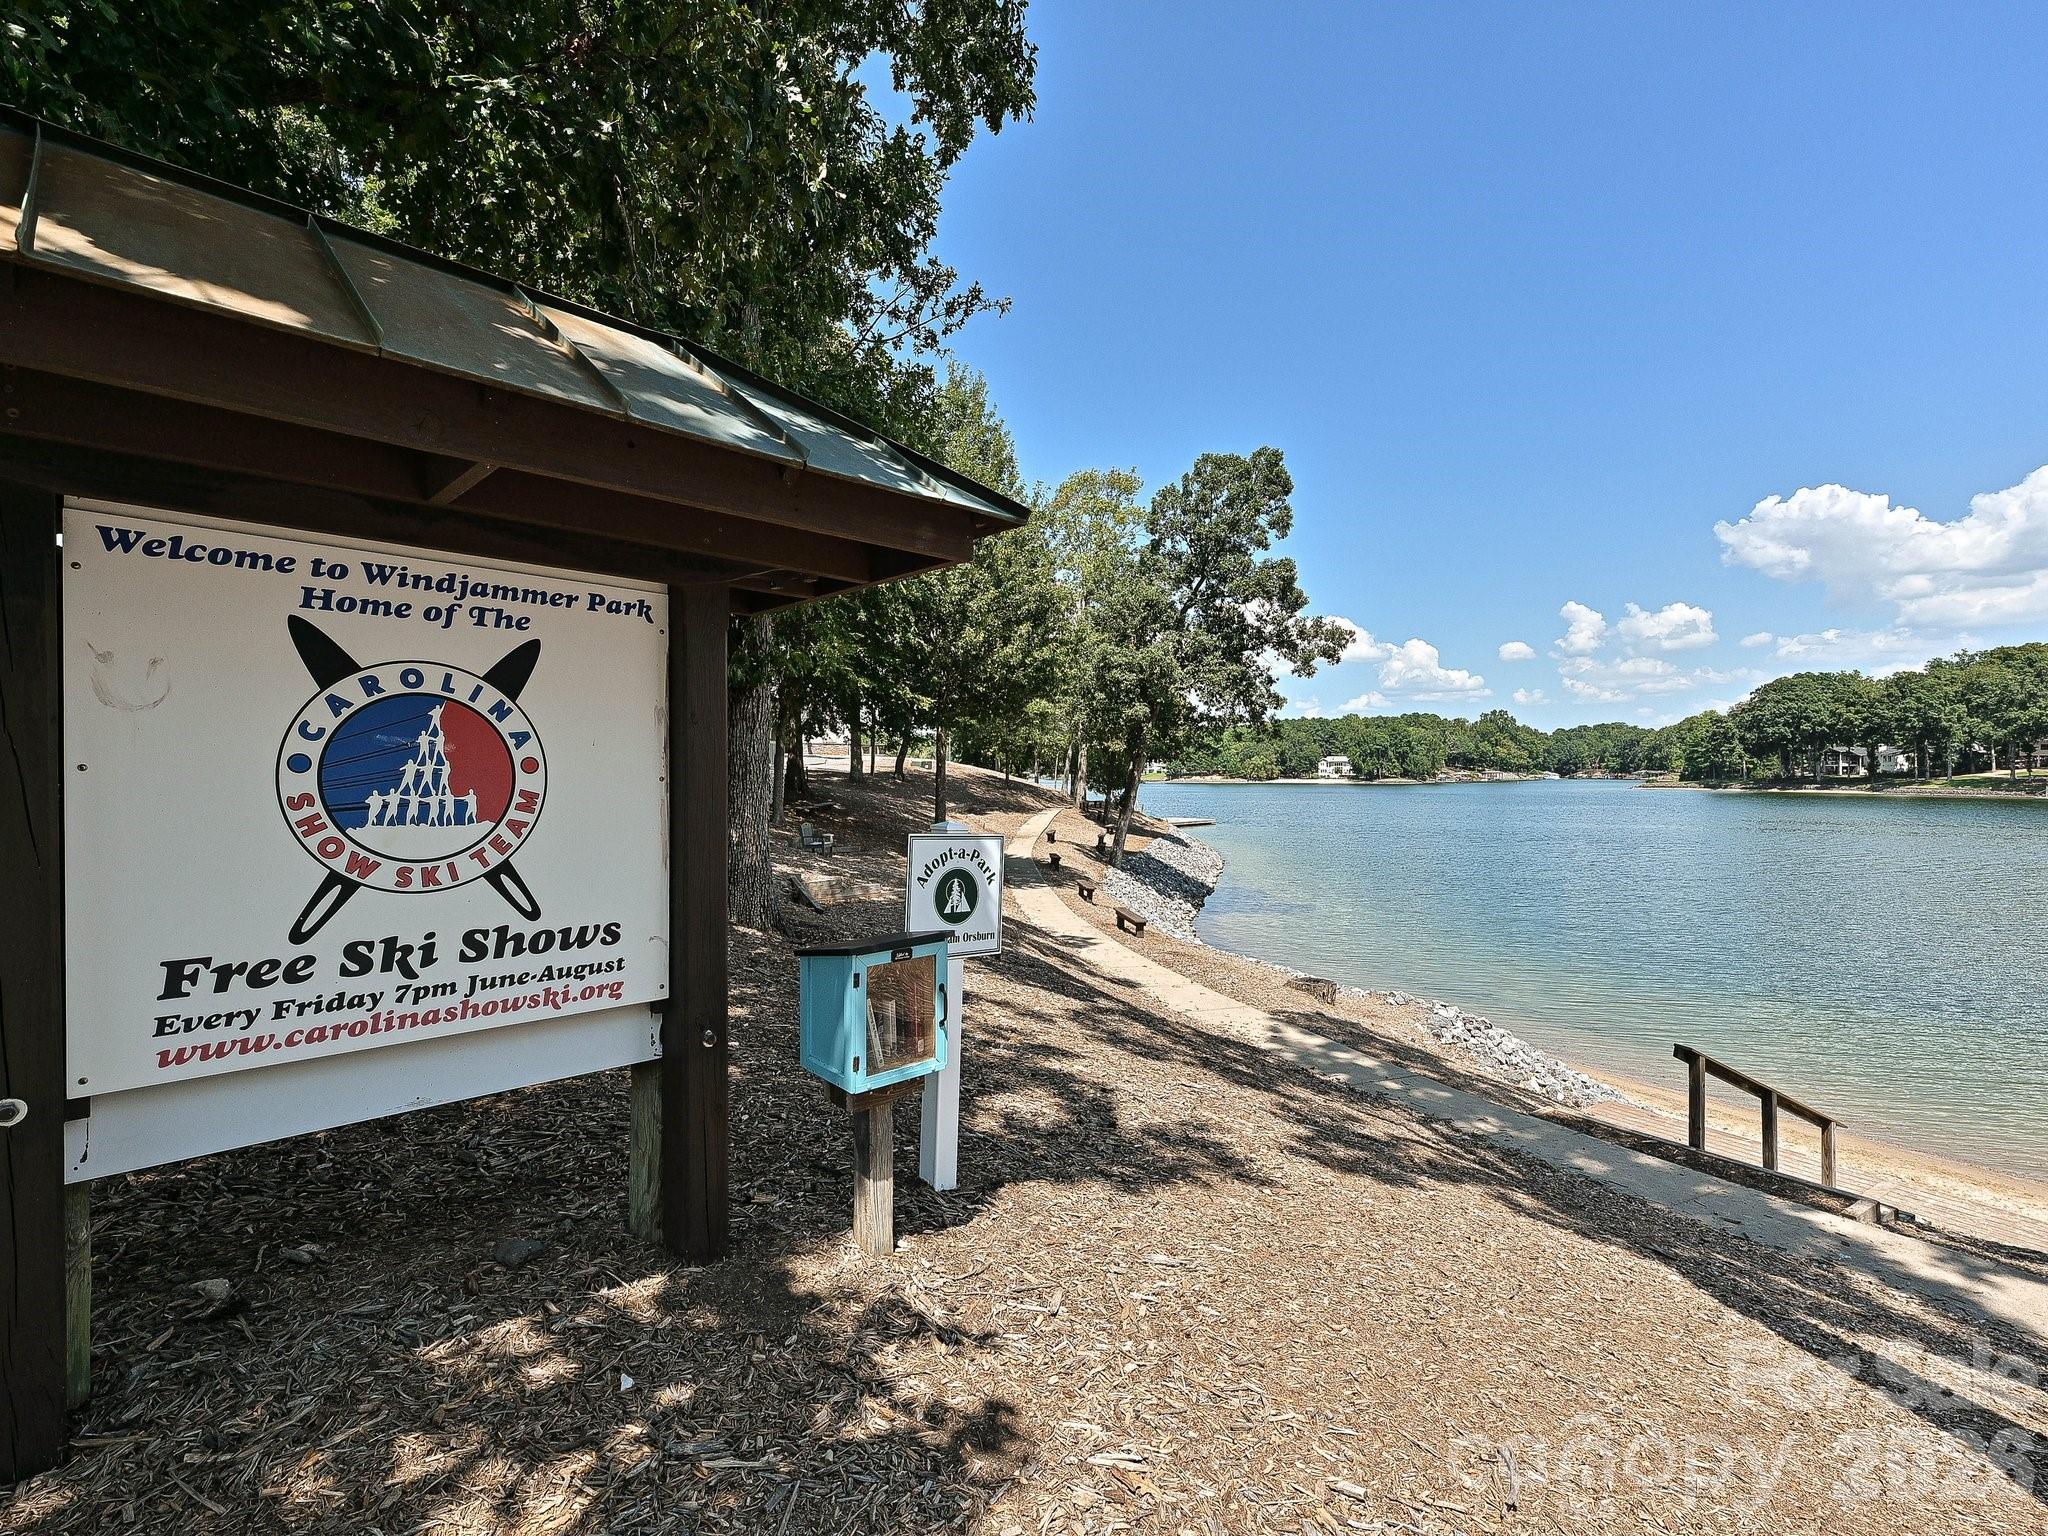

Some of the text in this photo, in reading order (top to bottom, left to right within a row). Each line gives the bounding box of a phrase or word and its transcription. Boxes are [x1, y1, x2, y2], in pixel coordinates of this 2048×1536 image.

[95, 525, 654, 624] Welcome to Windjammer Park
[299, 586, 531, 631] Home of The
[298, 668, 532, 750] CAROLINA
[286, 788, 541, 889] SHOW SKI TEAM
[916, 848, 996, 889] Adopt-a-Park
[156, 921, 622, 1001] Free Ski Shows
[963, 931, 995, 942] Orsburn
[151, 956, 626, 1038] Every Friday 7pm June-August
[155, 980, 625, 1069] www.carolinashowski.org
